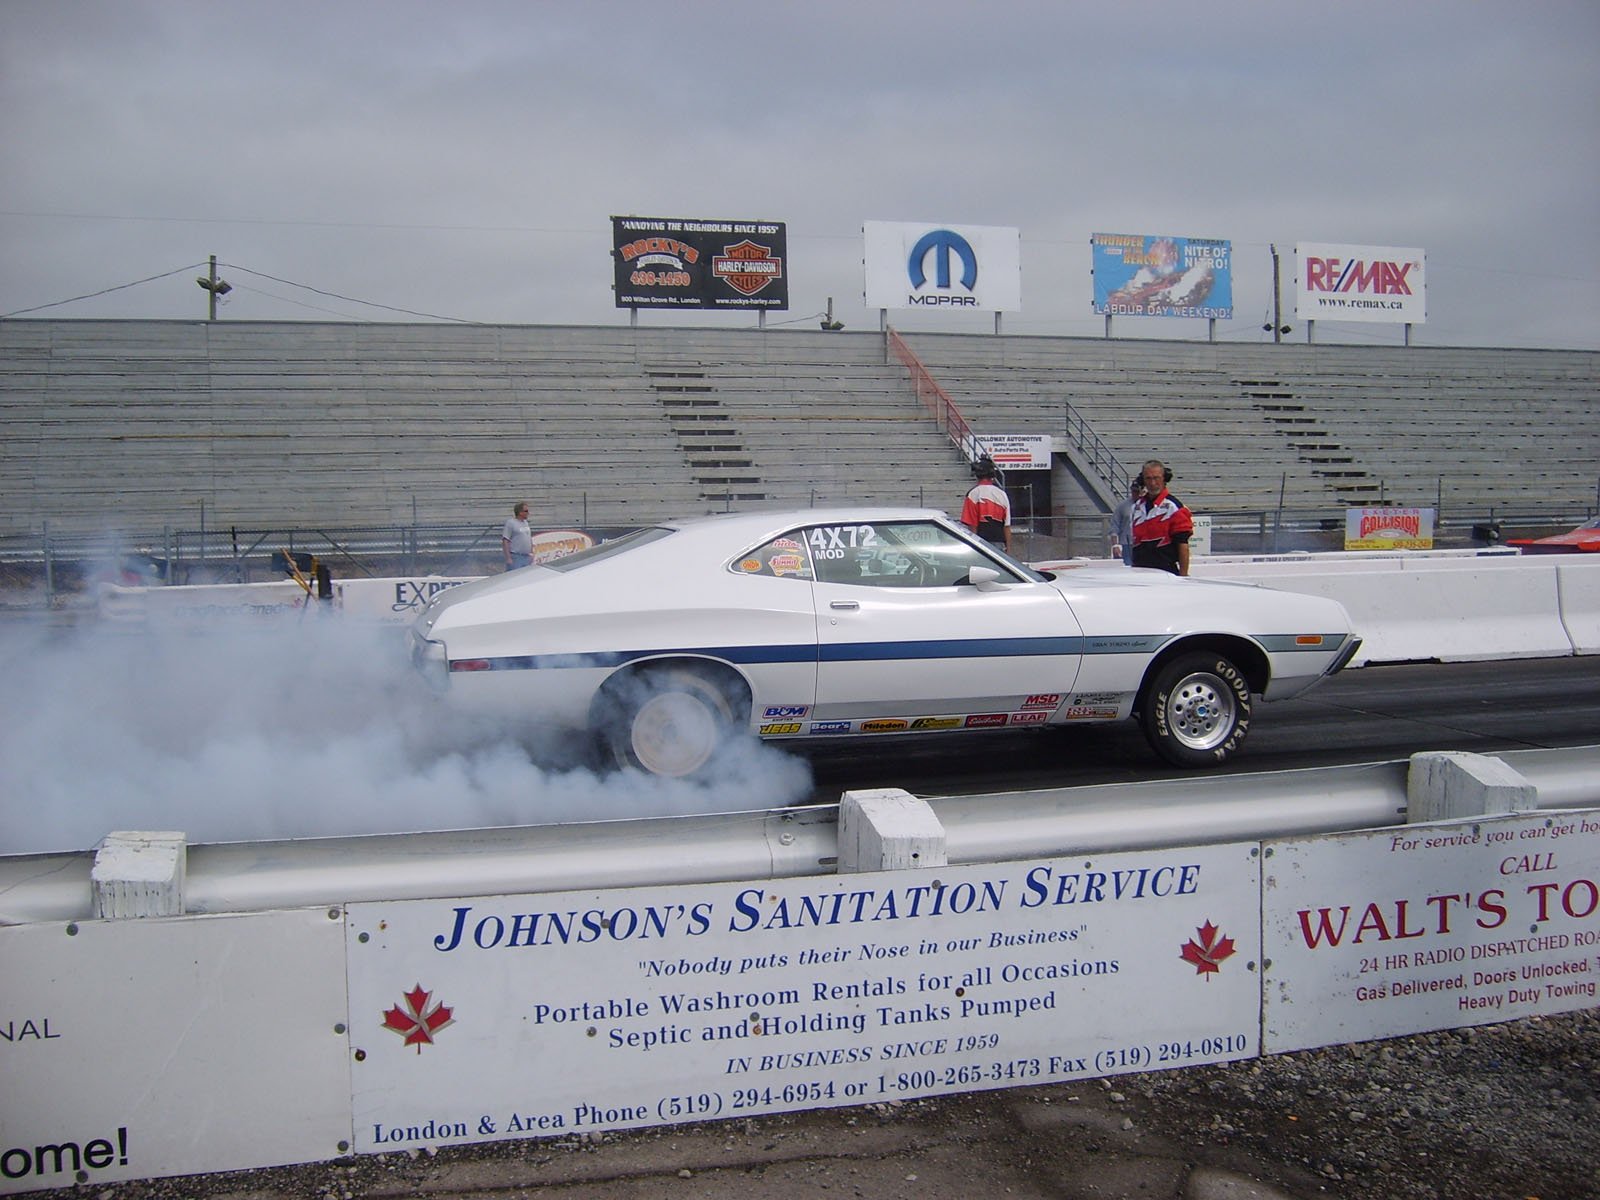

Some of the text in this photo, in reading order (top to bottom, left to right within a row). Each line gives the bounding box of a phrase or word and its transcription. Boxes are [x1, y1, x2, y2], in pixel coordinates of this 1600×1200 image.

[667, 222, 681, 230] THE
[683, 223, 732, 233] NEIGHBOURS
[734, 225, 756, 233] SINCE
[619, 238, 699, 264] ROCKY'S
[731, 244, 762, 258] MOTOR
[1184, 245, 1227, 258] NITE OF
[1184, 257, 1228, 269] NITRO!
[718, 261, 776, 272] HARLEY-DAVIDSON
[1307, 257, 1412, 295] RE/MAX
[909, 295, 975, 306] MOPAR
[1096, 304, 1230, 318] LABOUR DAY WEEKEND!
[1319, 298, 1402, 309] www.remax.ca
[810, 525, 877, 548] 4X72
[1360, 516, 1420, 538] COLLISION
[773, 559, 796, 567] SUMMIT
[815, 550, 845, 560] MOD
[1026, 695, 1059, 704] MSD
[1214, 661, 1251, 760] GOODYEAR
[1156, 691, 1169, 736] EAGLE
[761, 723, 802, 734] JEGS
[1391, 837, 1419, 852] For
[1425, 833, 1480, 849] service
[1486, 830, 1513, 846] you
[1519, 828, 1546, 841] can
[1551, 824, 1575, 839] get
[1500, 853, 1558, 875] CALL
[434, 865, 1201, 952] JOHNSON'S SANITATION SERVICE
[1296, 889, 1507, 950] WALT'S
[639, 924, 1087, 978] "Nobody puts their Nose in our Business"
[1359, 959, 1378, 974] 24
[1385, 954, 1408, 971] HR
[1414, 947, 1465, 966] RADIO
[1471, 935, 1569, 960] DISPATCHED
[534, 958, 1120, 1025] Portable Washroom Rentals for all Occasions
[1356, 987, 1386, 1001] Gas
[1392, 977, 1467, 997] Delivered,
[1474, 969, 1516, 985] Doors
[1522, 959, 1592, 980] Unlocked,
[1459, 982, 1596, 1010] Heavy Duty Towing
[609, 992, 1056, 1051] Septic and Holding Tanks Pumped
[725, 1033, 999, 1075] IN BUSINESS SINCE 1959
[374, 1033, 1247, 1144] London & Area Phone (519) 294-6954 or 1-800-265-3473 Fax (519) 294-0810
